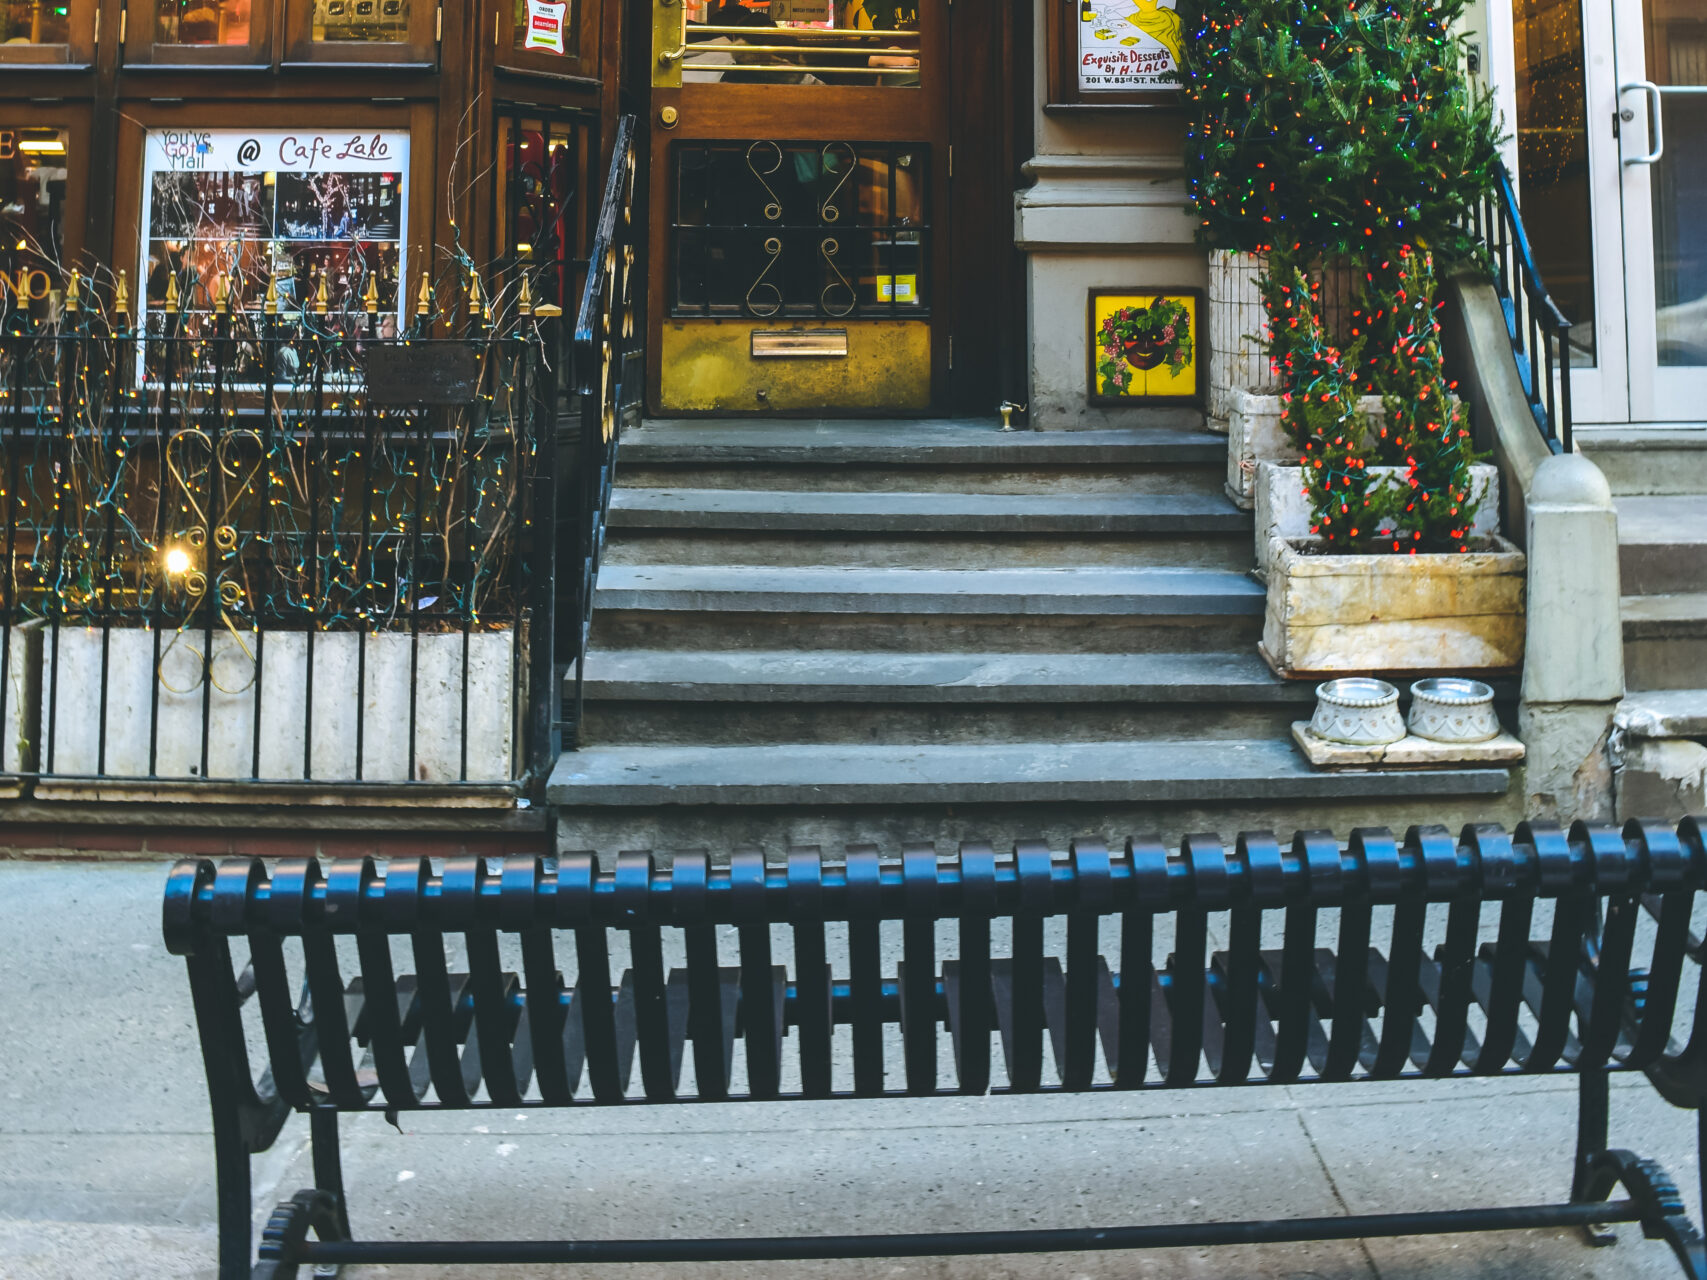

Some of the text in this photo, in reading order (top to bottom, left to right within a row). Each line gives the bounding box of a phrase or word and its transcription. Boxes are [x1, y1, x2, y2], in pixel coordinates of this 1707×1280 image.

[1136, 60, 1168, 73] LALO
[1085, 76, 1100, 84] 201
[165, 141, 196, 158] Got
[236, 133, 393, 169] @ Cafe Lalo
[172, 151, 205, 169] Mail
